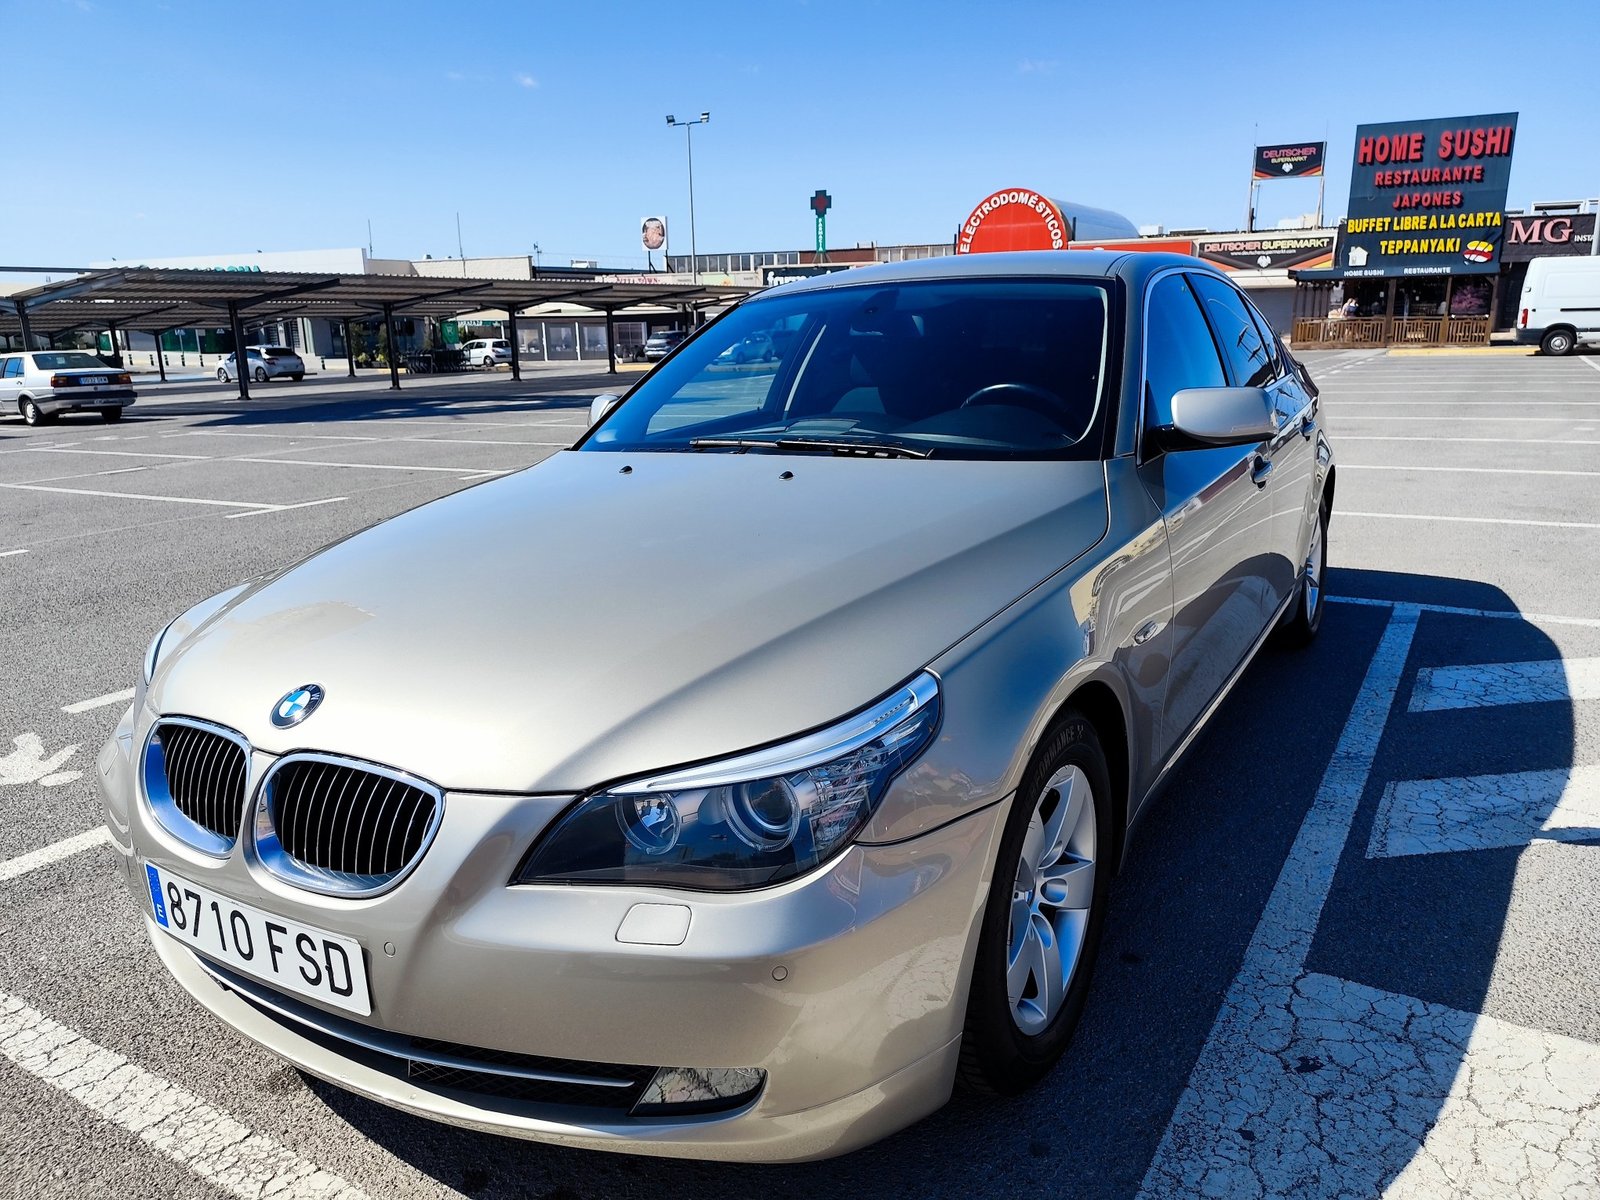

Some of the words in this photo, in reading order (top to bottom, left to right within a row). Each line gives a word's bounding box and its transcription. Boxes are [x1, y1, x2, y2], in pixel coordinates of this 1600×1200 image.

[1263, 147, 1316, 159] DEUTSCHER
[1358, 133, 1424, 164] HOME
[1438, 127, 1513, 159] SUSHI
[1271, 155, 1307, 164] SUPERMARKT
[1374, 165, 1483, 186] RESTAURANTE
[1392, 191, 1463, 209] JAPONES
[960, 191, 1063, 253] ELECTRODOMÉSTICOS
[1347, 217, 1392, 234] BUFFET
[1393, 215, 1427, 231] LIBRE
[1428, 213, 1438, 230] A
[1440, 213, 1457, 229] LA
[1458, 211, 1502, 228] CARTA
[1508, 217, 1574, 245] MG
[1204, 241, 1261, 252] DEUTSCHER
[1262, 237, 1330, 250] SUPERMARKT
[1380, 238, 1461, 255] TEPPANYAKI
[1403, 266, 1451, 275] RESTAURANTE
[156, 904, 165, 919] E
[167, 882, 254, 961] 8710
[265, 921, 353, 998] FSD
